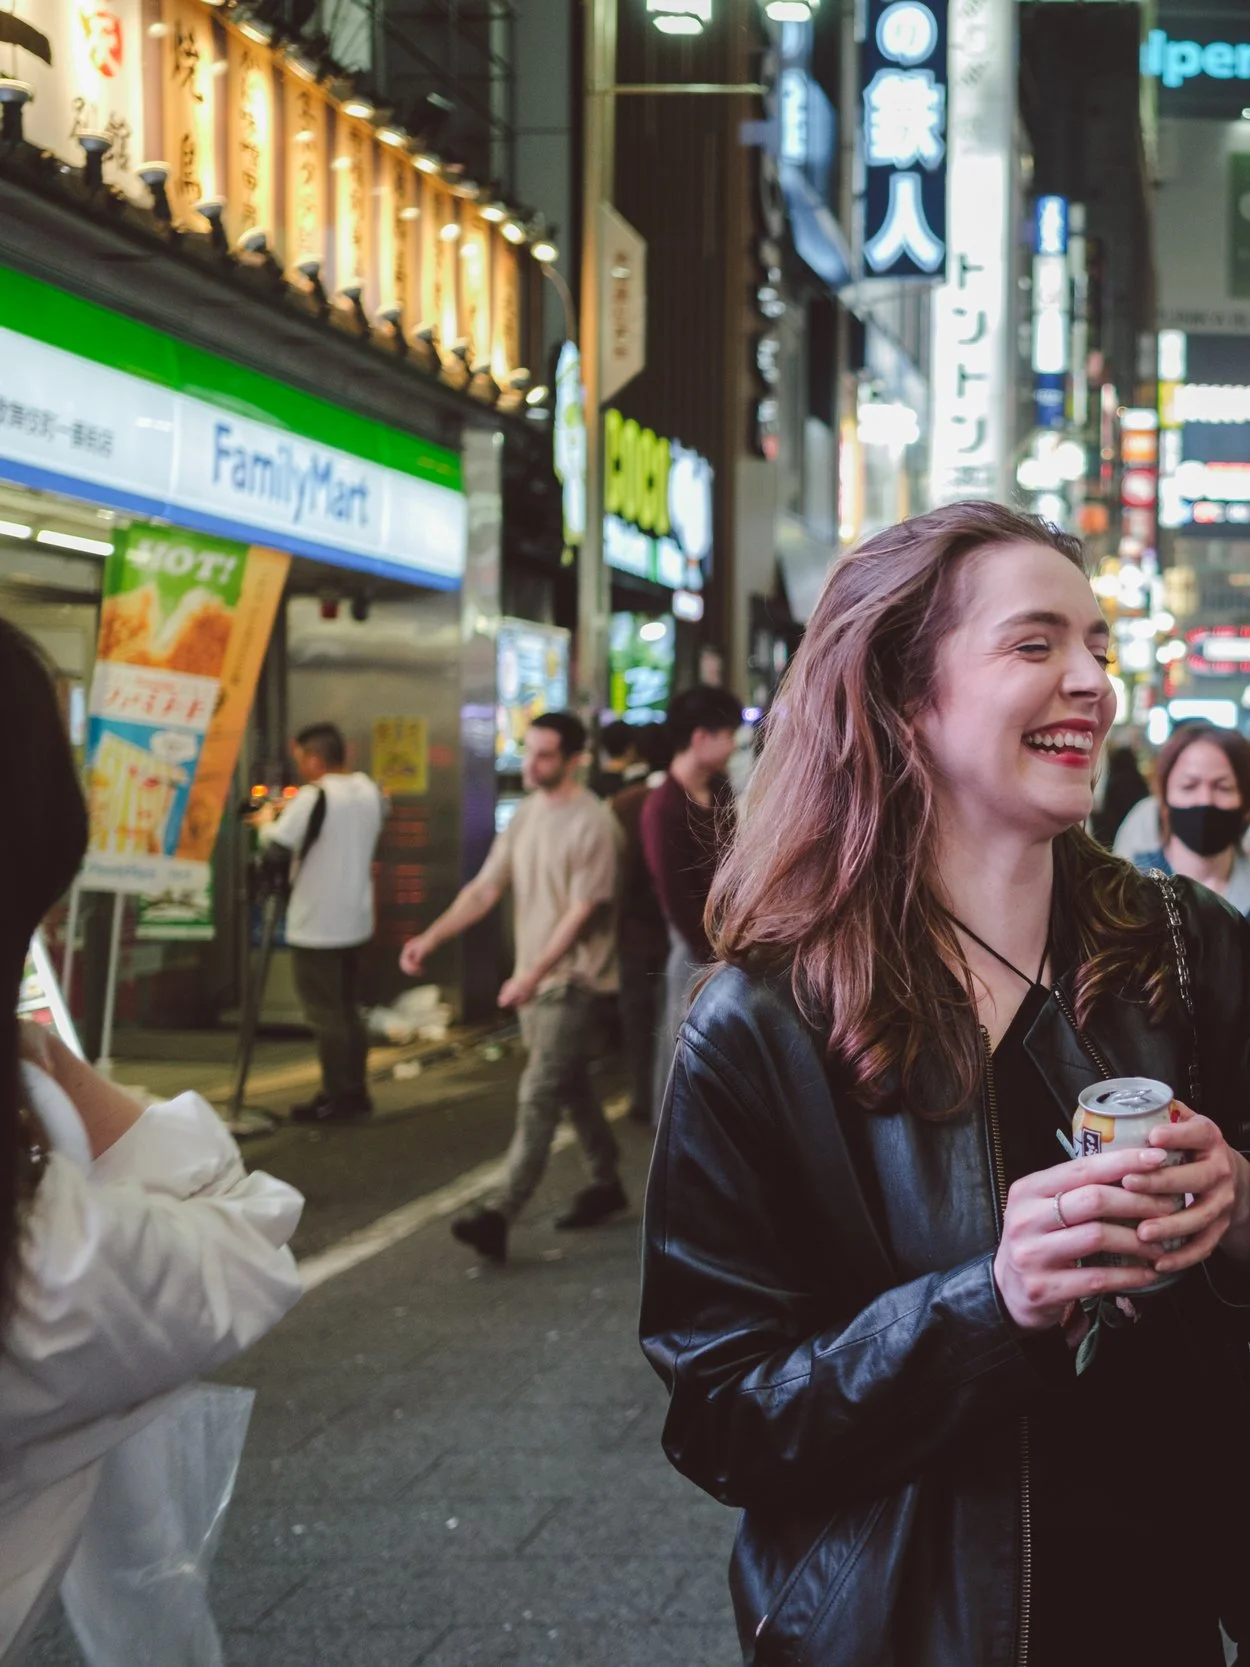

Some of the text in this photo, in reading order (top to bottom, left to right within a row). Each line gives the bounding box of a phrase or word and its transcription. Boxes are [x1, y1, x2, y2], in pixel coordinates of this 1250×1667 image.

[951, 252, 988, 453] トントン
[211, 422, 371, 526] FamilyMart
